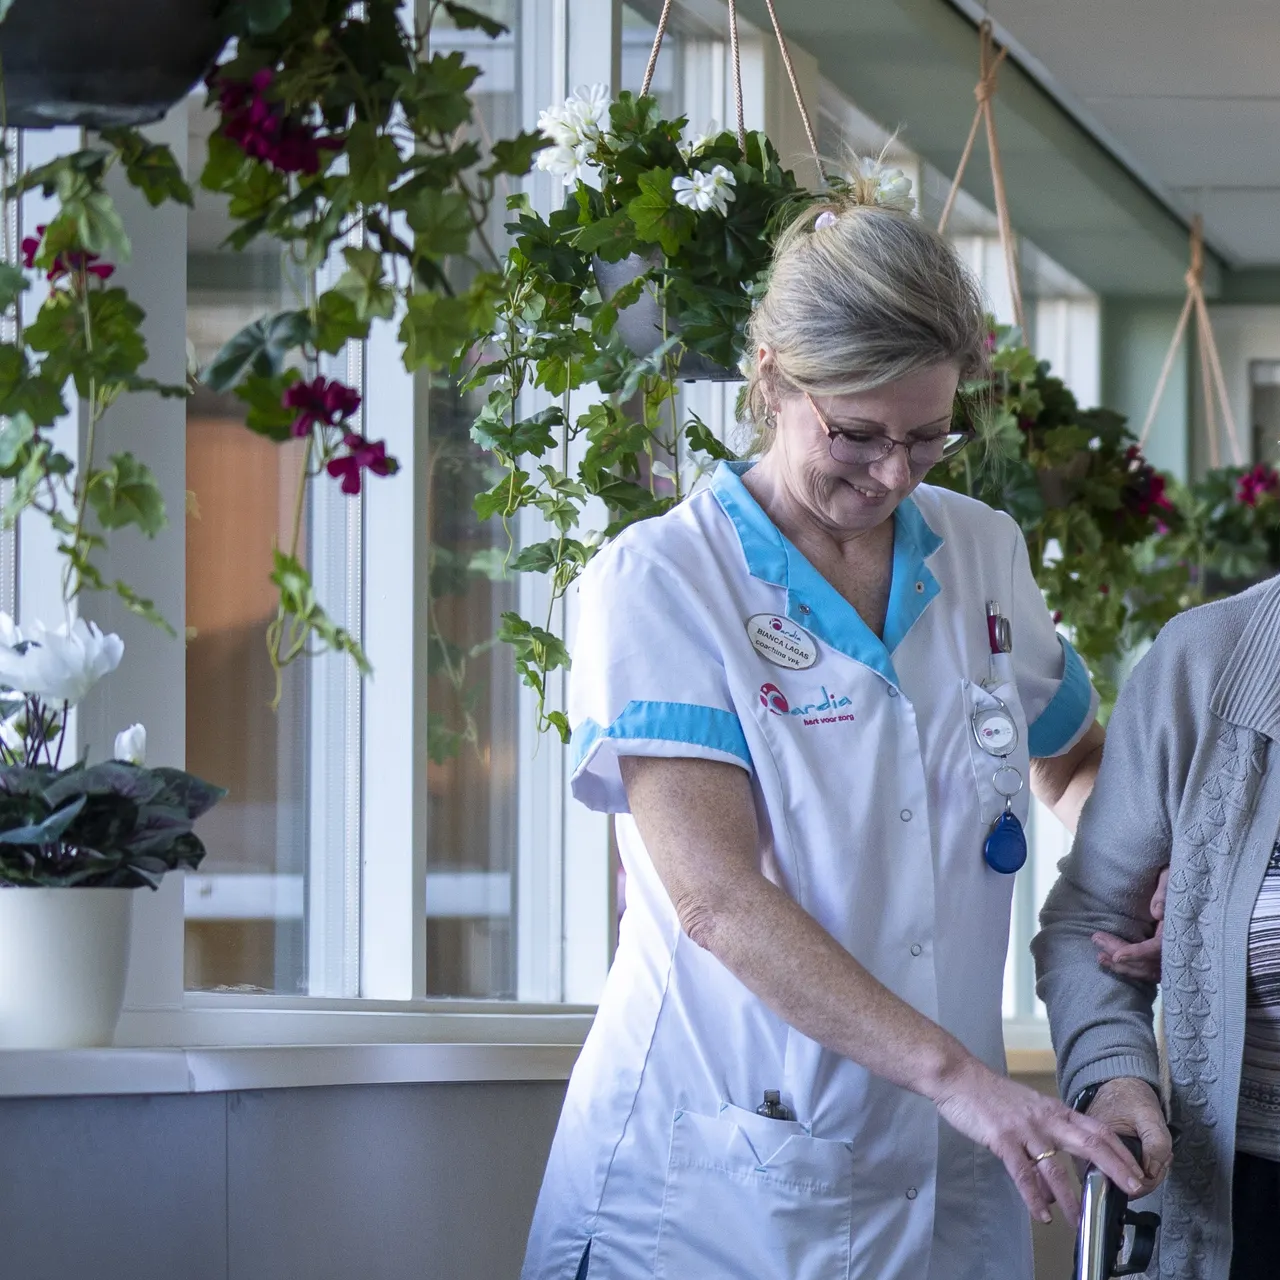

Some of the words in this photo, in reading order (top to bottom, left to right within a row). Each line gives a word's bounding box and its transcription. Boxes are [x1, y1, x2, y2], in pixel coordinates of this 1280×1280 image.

[755, 640, 787, 659] coaching
[757, 628, 784, 647] BIANCA
[785, 643, 809, 660] LAGAS
